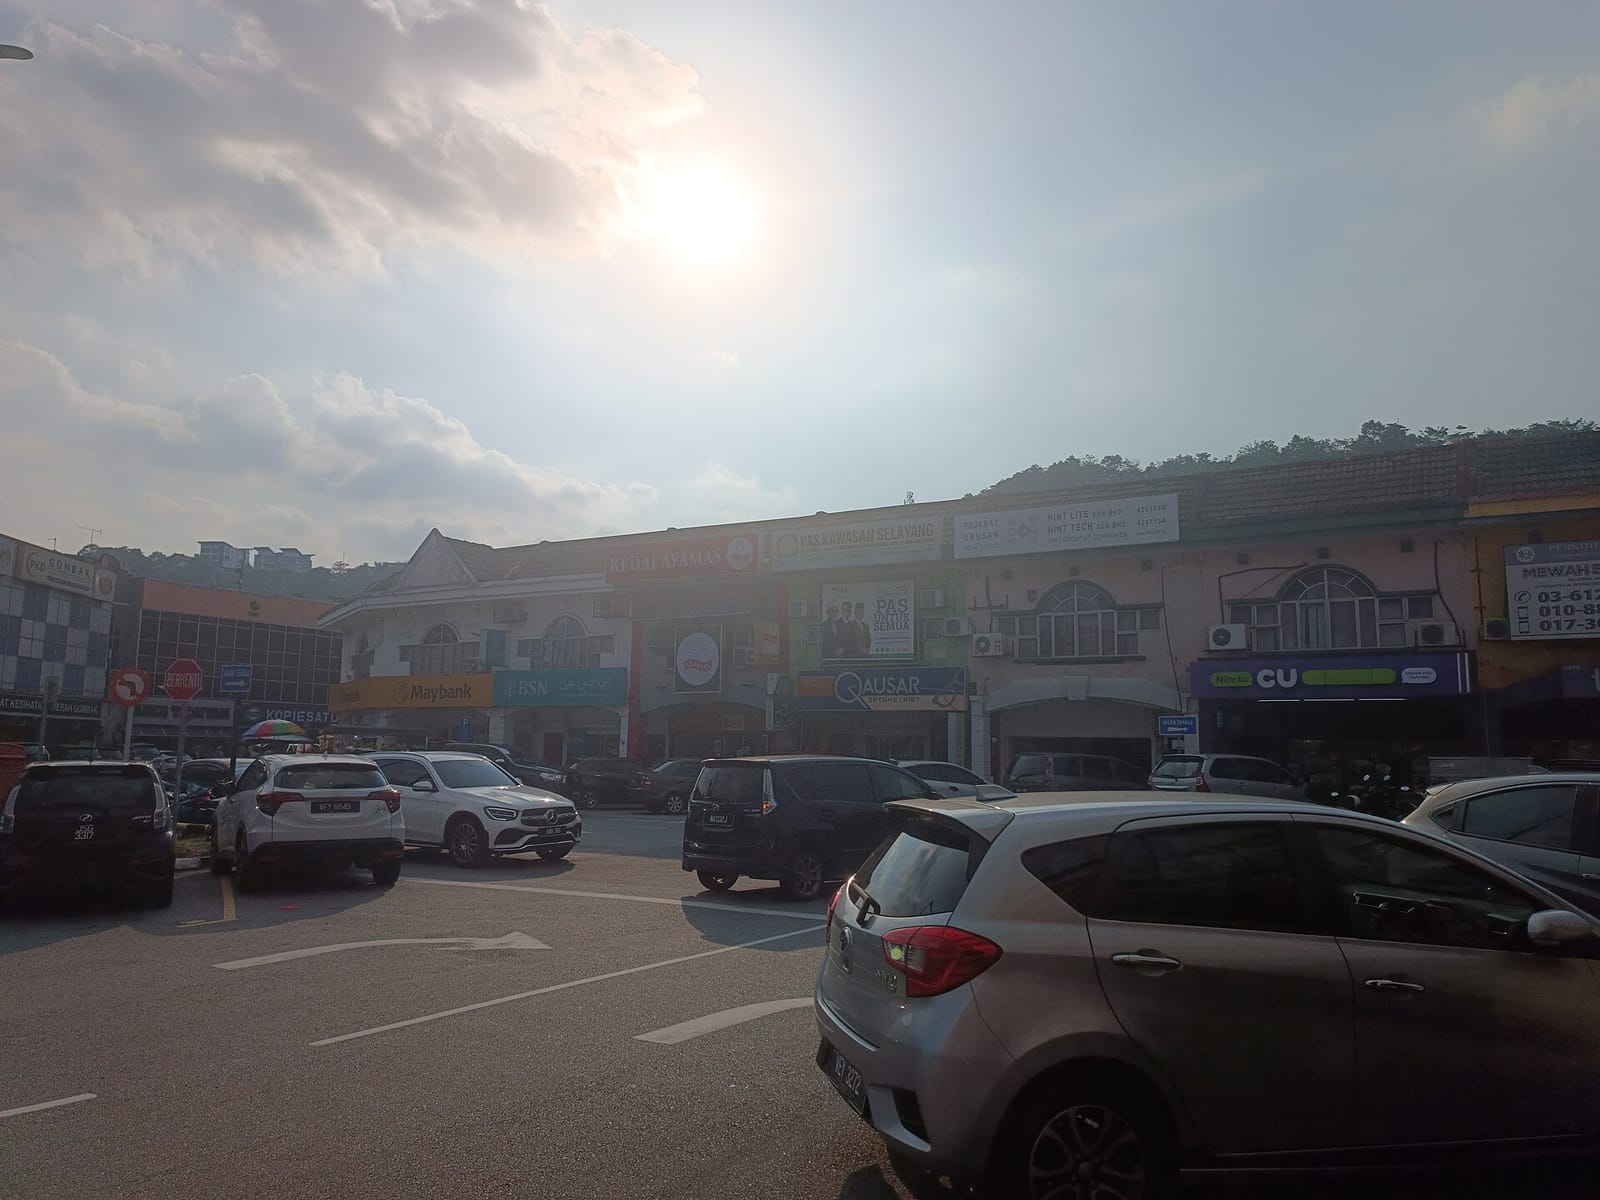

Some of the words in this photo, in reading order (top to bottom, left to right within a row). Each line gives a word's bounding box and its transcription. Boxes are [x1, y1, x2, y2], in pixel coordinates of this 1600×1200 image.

[1047, 511, 1067, 521] HINT
[1070, 509, 1089, 519] LITE
[800, 533, 819, 548] PAS
[822, 528, 874, 545] KAWASAN
[877, 523, 934, 541] SELAYANG
[1047, 523, 1067, 534] HINT
[1071, 522, 1094, 532] TECH
[610, 552, 656, 573] KEDAI
[661, 547, 721, 569] AYAMAS
[49, 558, 90, 578] GOMBAK
[876, 598, 908, 613] PAS
[873, 612, 910, 622] UNTUK
[873, 621, 910, 632] SEMUA
[1540, 618, 1600, 632] 017-3
[166, 672, 200, 688] BERHENTI
[1216, 675, 1237, 683] Nice
[1256, 668, 1298, 689] CU
[410, 683, 472, 702] Maybank
[519, 680, 548, 696] BSN
[834, 671, 920, 710] QAUSAR
[10, 698, 43, 710] KESIHATA
[266, 709, 338, 723] KOPIESATU
